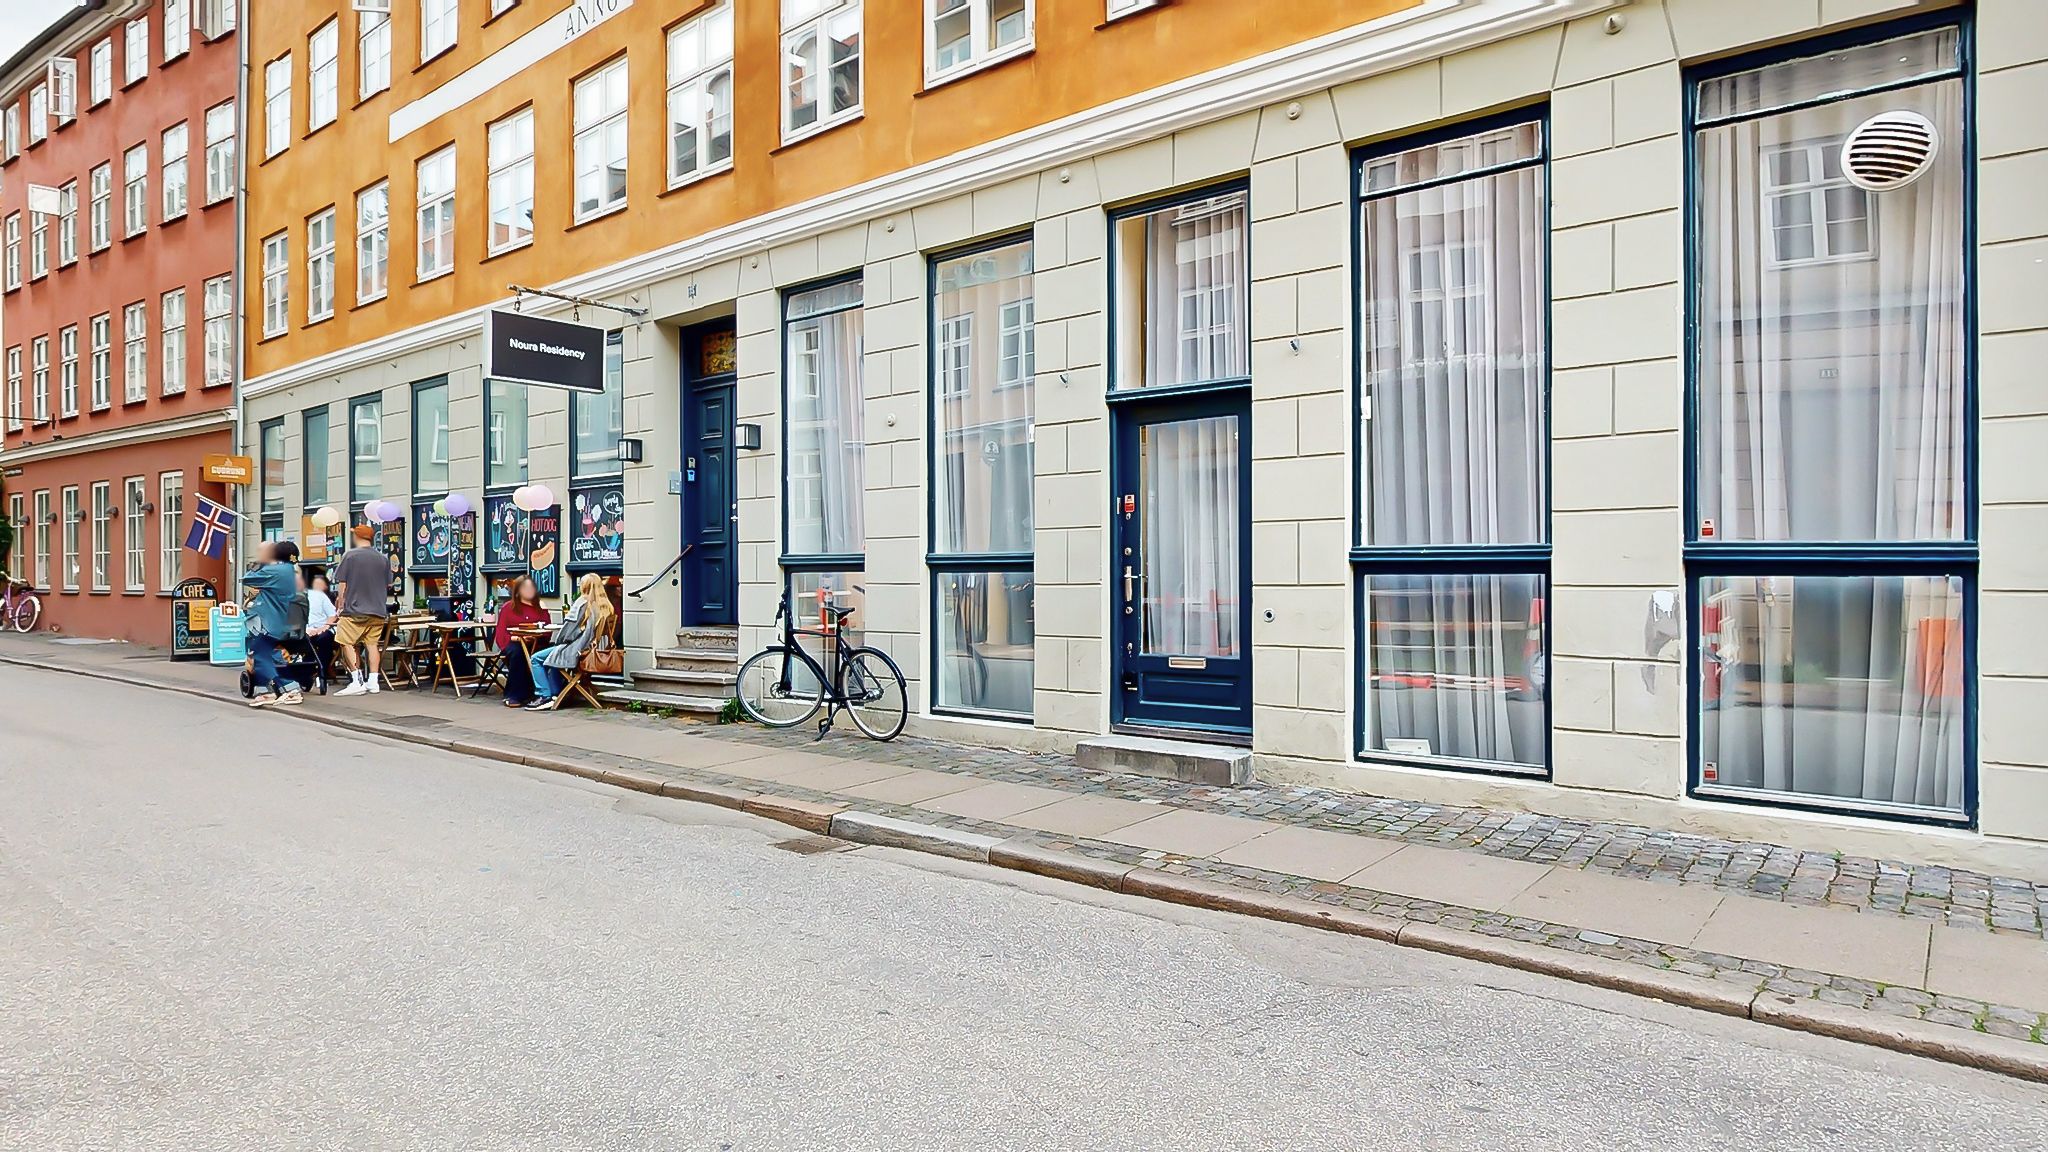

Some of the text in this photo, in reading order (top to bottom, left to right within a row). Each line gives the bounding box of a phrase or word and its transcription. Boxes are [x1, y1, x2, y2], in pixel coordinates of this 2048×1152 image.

[509, 337, 586, 361] Noura Residency
[544, 518, 557, 532] DOG
